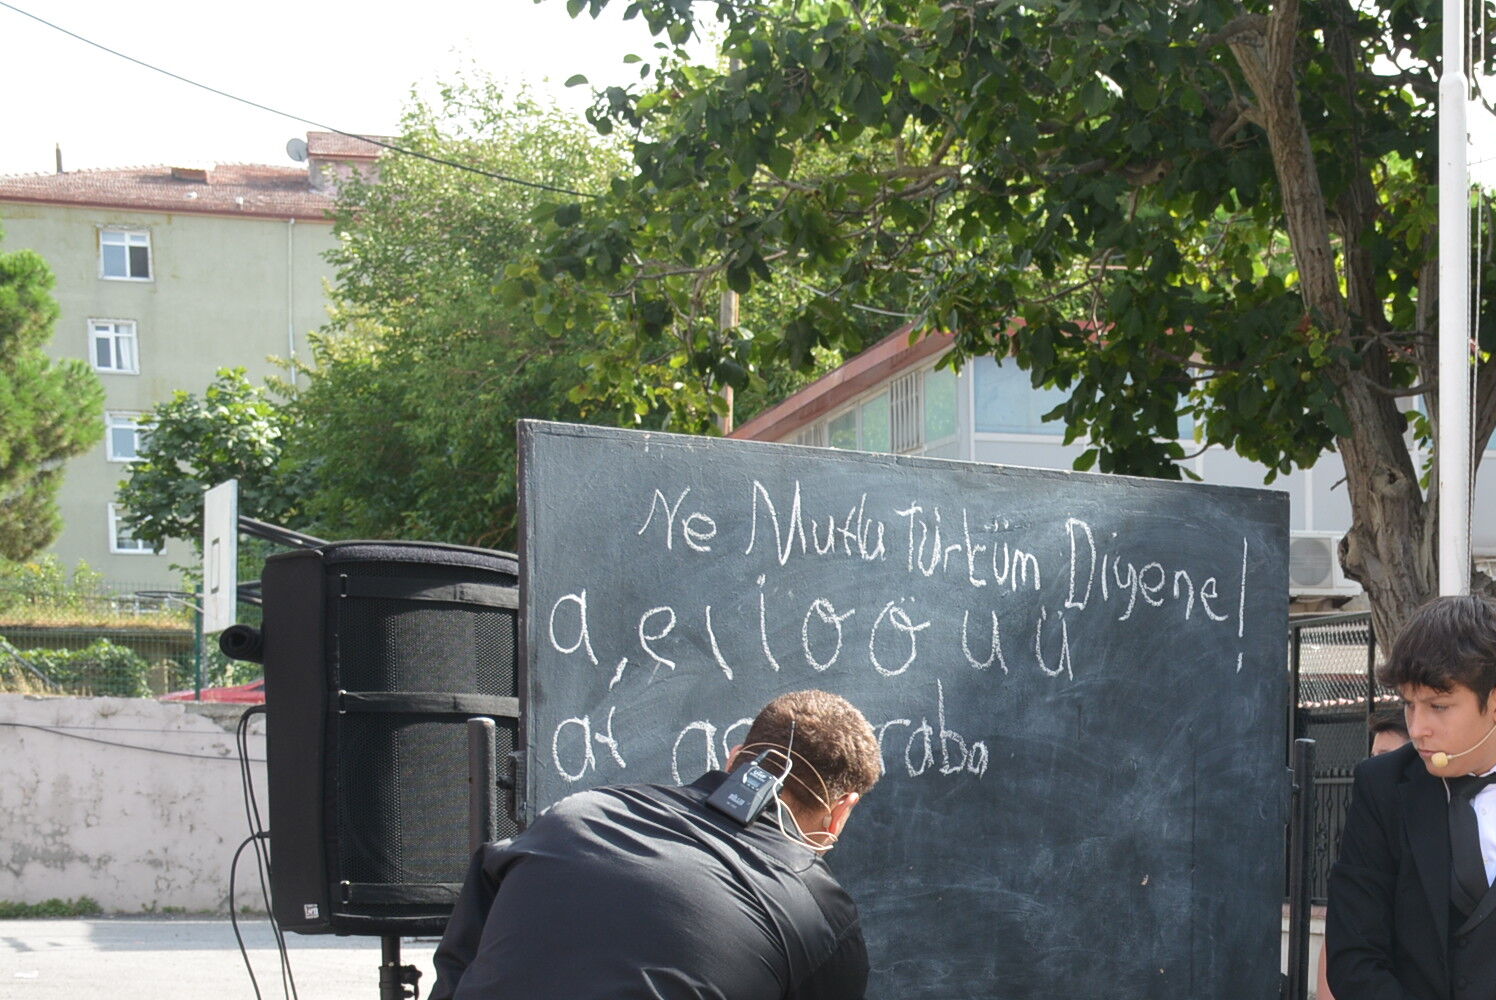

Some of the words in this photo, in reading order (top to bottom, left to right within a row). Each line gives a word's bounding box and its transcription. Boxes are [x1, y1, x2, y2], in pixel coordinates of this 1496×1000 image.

[637, 485, 717, 551] Ne
[744, 478, 886, 567] Mutlu
[801, 598, 856, 672] o
[868, 596, 931, 677] ö
[962, 609, 1009, 675] u
[1034, 604, 1074, 682] ü
